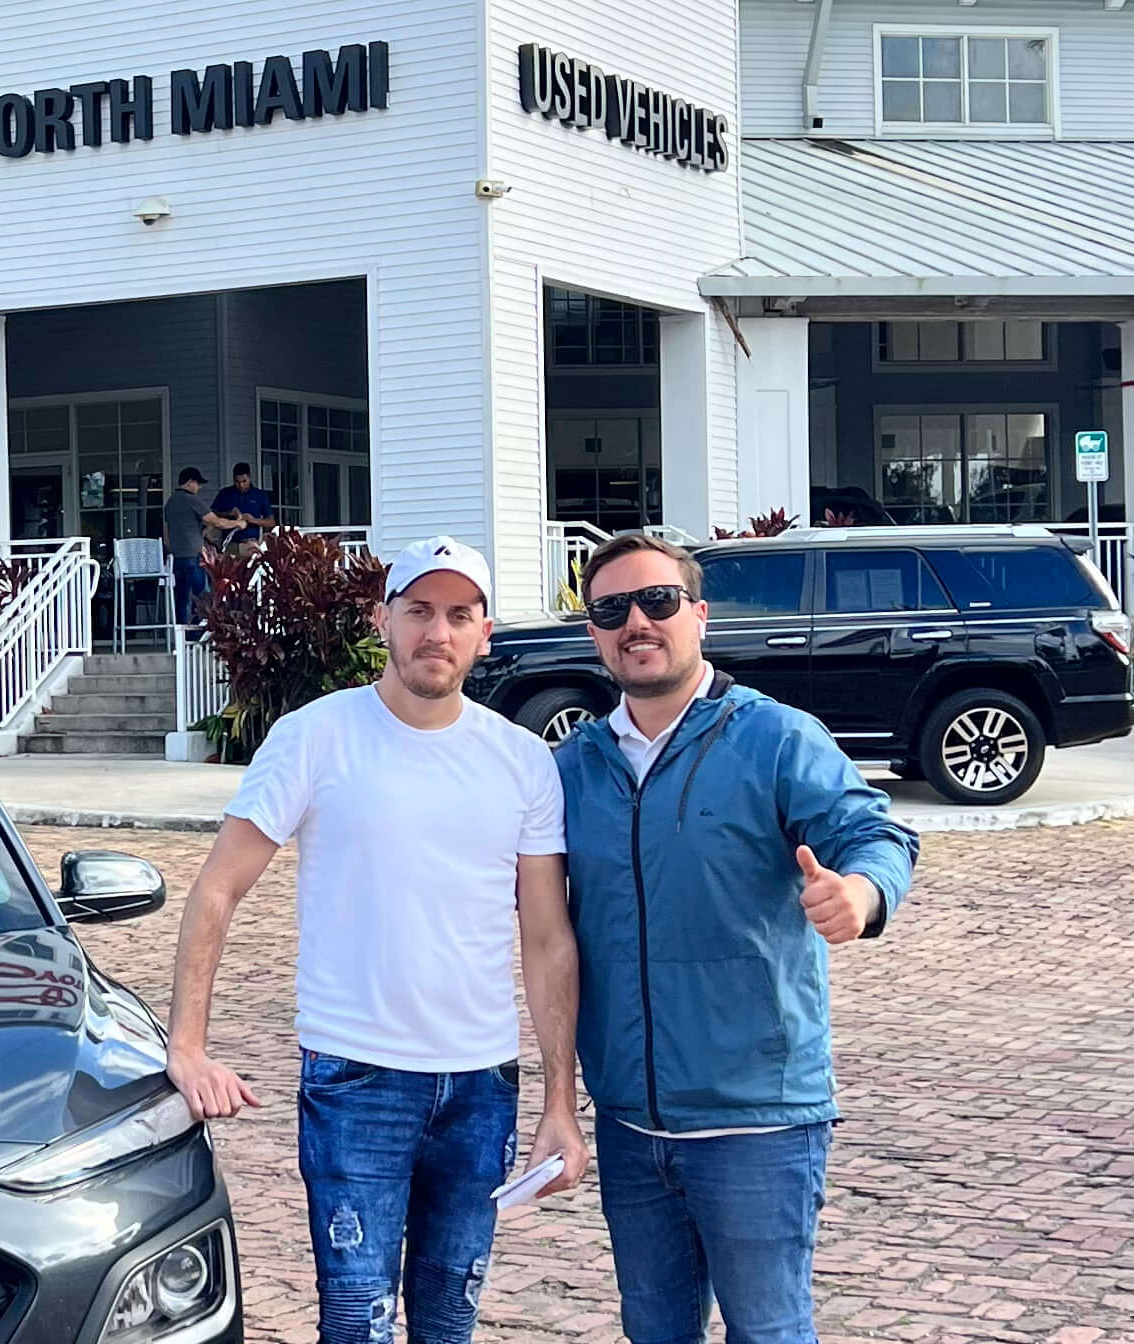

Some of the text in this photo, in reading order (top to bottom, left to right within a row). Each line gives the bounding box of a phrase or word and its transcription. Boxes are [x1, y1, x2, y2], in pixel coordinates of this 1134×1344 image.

[170, 41, 391, 137] MIAMI
[518, 42, 730, 174] USED VEHICLES
